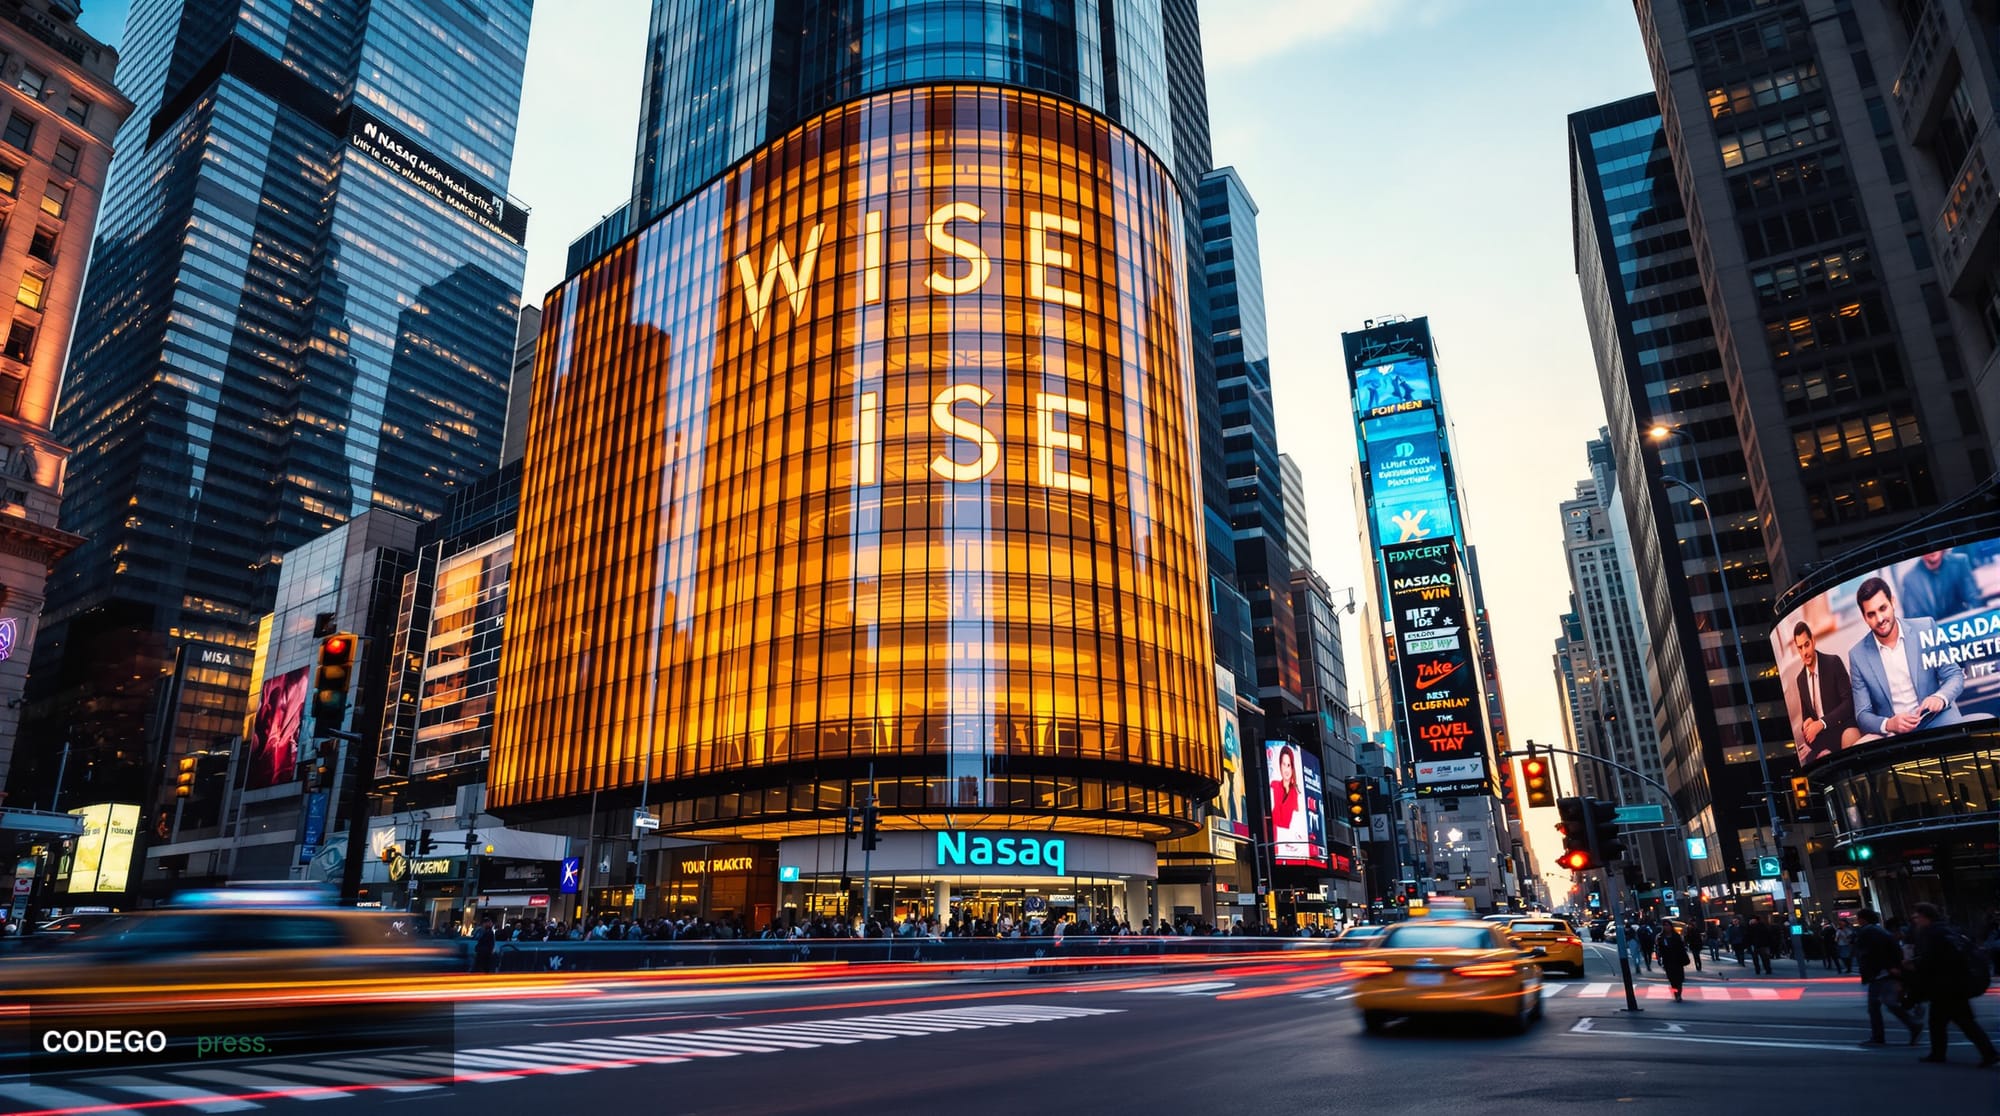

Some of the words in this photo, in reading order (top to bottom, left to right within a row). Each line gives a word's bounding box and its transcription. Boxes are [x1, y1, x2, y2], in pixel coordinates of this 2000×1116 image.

[736, 202, 1082, 333] WISE
[859, 384, 1092, 492] ISE
[1421, 587, 1450, 600] WIN
[1420, 722, 1473, 739] LOVEL
[681, 860, 705, 874] YOUR
[937, 831, 1065, 876] Nasaq
